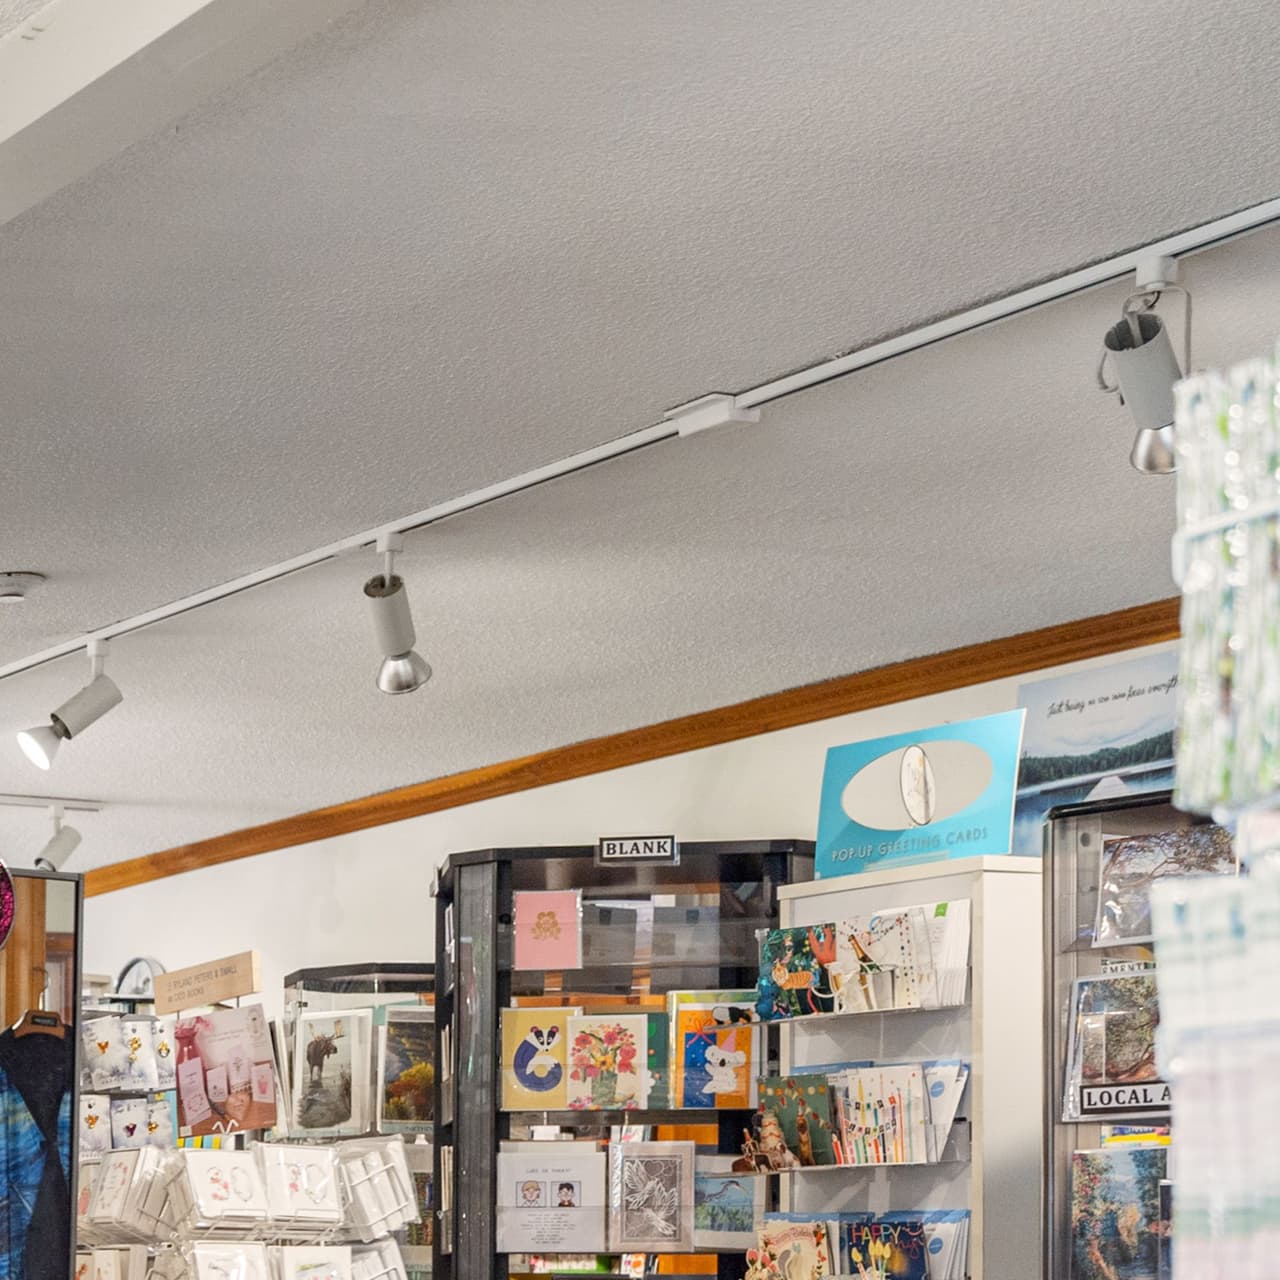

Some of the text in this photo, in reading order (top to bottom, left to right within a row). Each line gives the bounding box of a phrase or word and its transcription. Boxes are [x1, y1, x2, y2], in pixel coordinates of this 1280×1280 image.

[605, 840, 670, 856] BLANK
[878, 834, 941, 856] GREETING
[945, 827, 988, 845] CARDS
[1086, 1088, 1153, 1107] LOCAL
[851, 1222, 902, 1246] HAPPY
